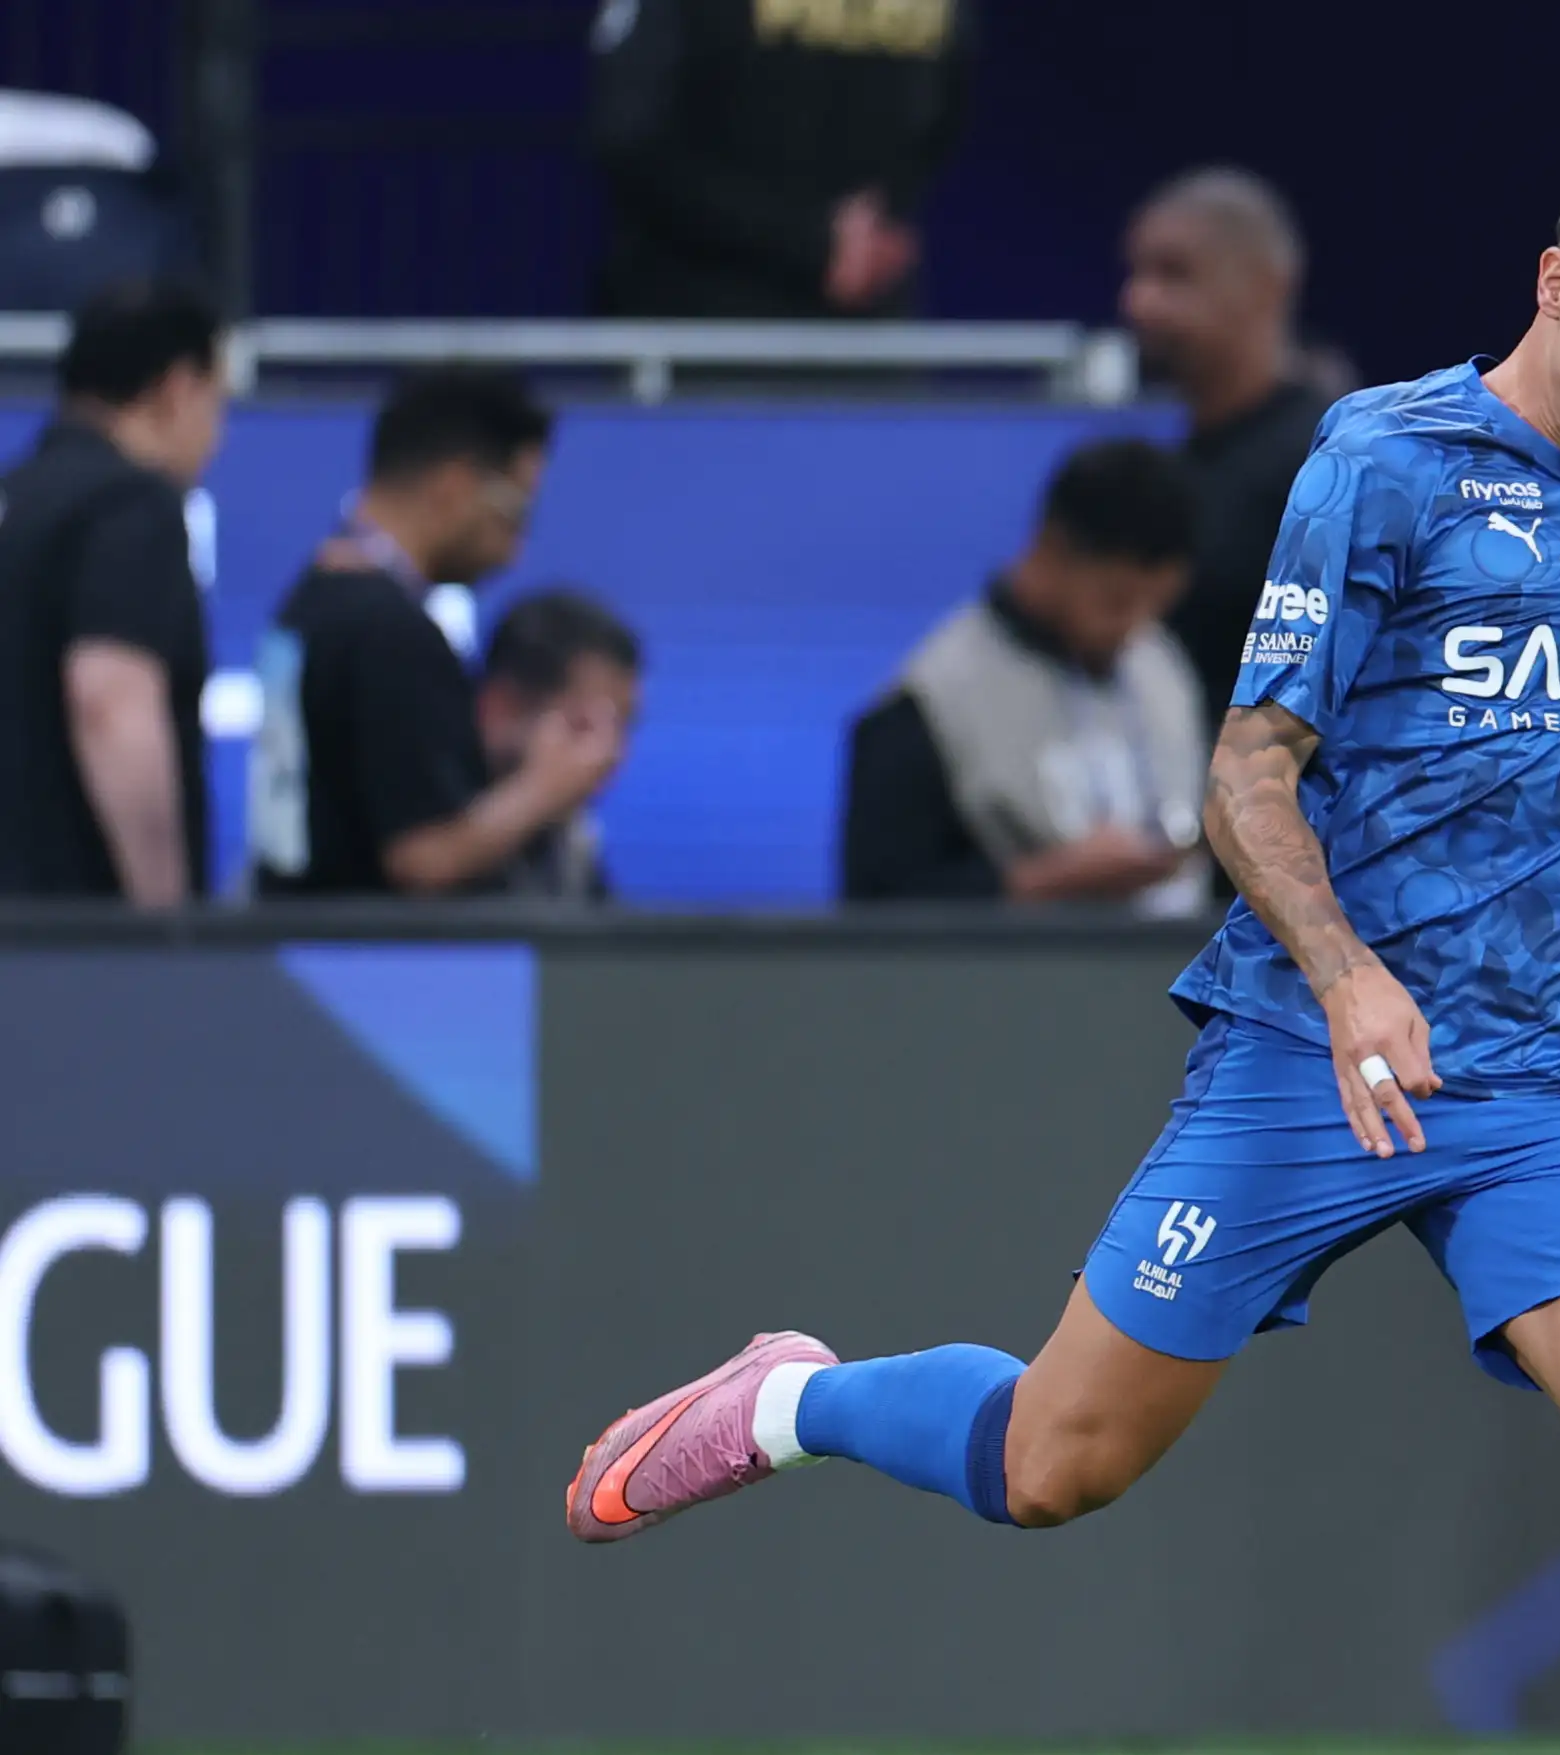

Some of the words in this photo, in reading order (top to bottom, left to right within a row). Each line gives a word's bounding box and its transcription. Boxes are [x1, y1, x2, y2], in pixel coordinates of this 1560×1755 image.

[1460, 479, 1541, 500] flynas
[1256, 580, 1328, 624] tree
[1258, 632, 1318, 652] SANAB
[1254, 651, 1308, 664] INVESTME
[1137, 1259, 1183, 1288] ALHILAL
[0, 1193, 468, 1497] GUE
